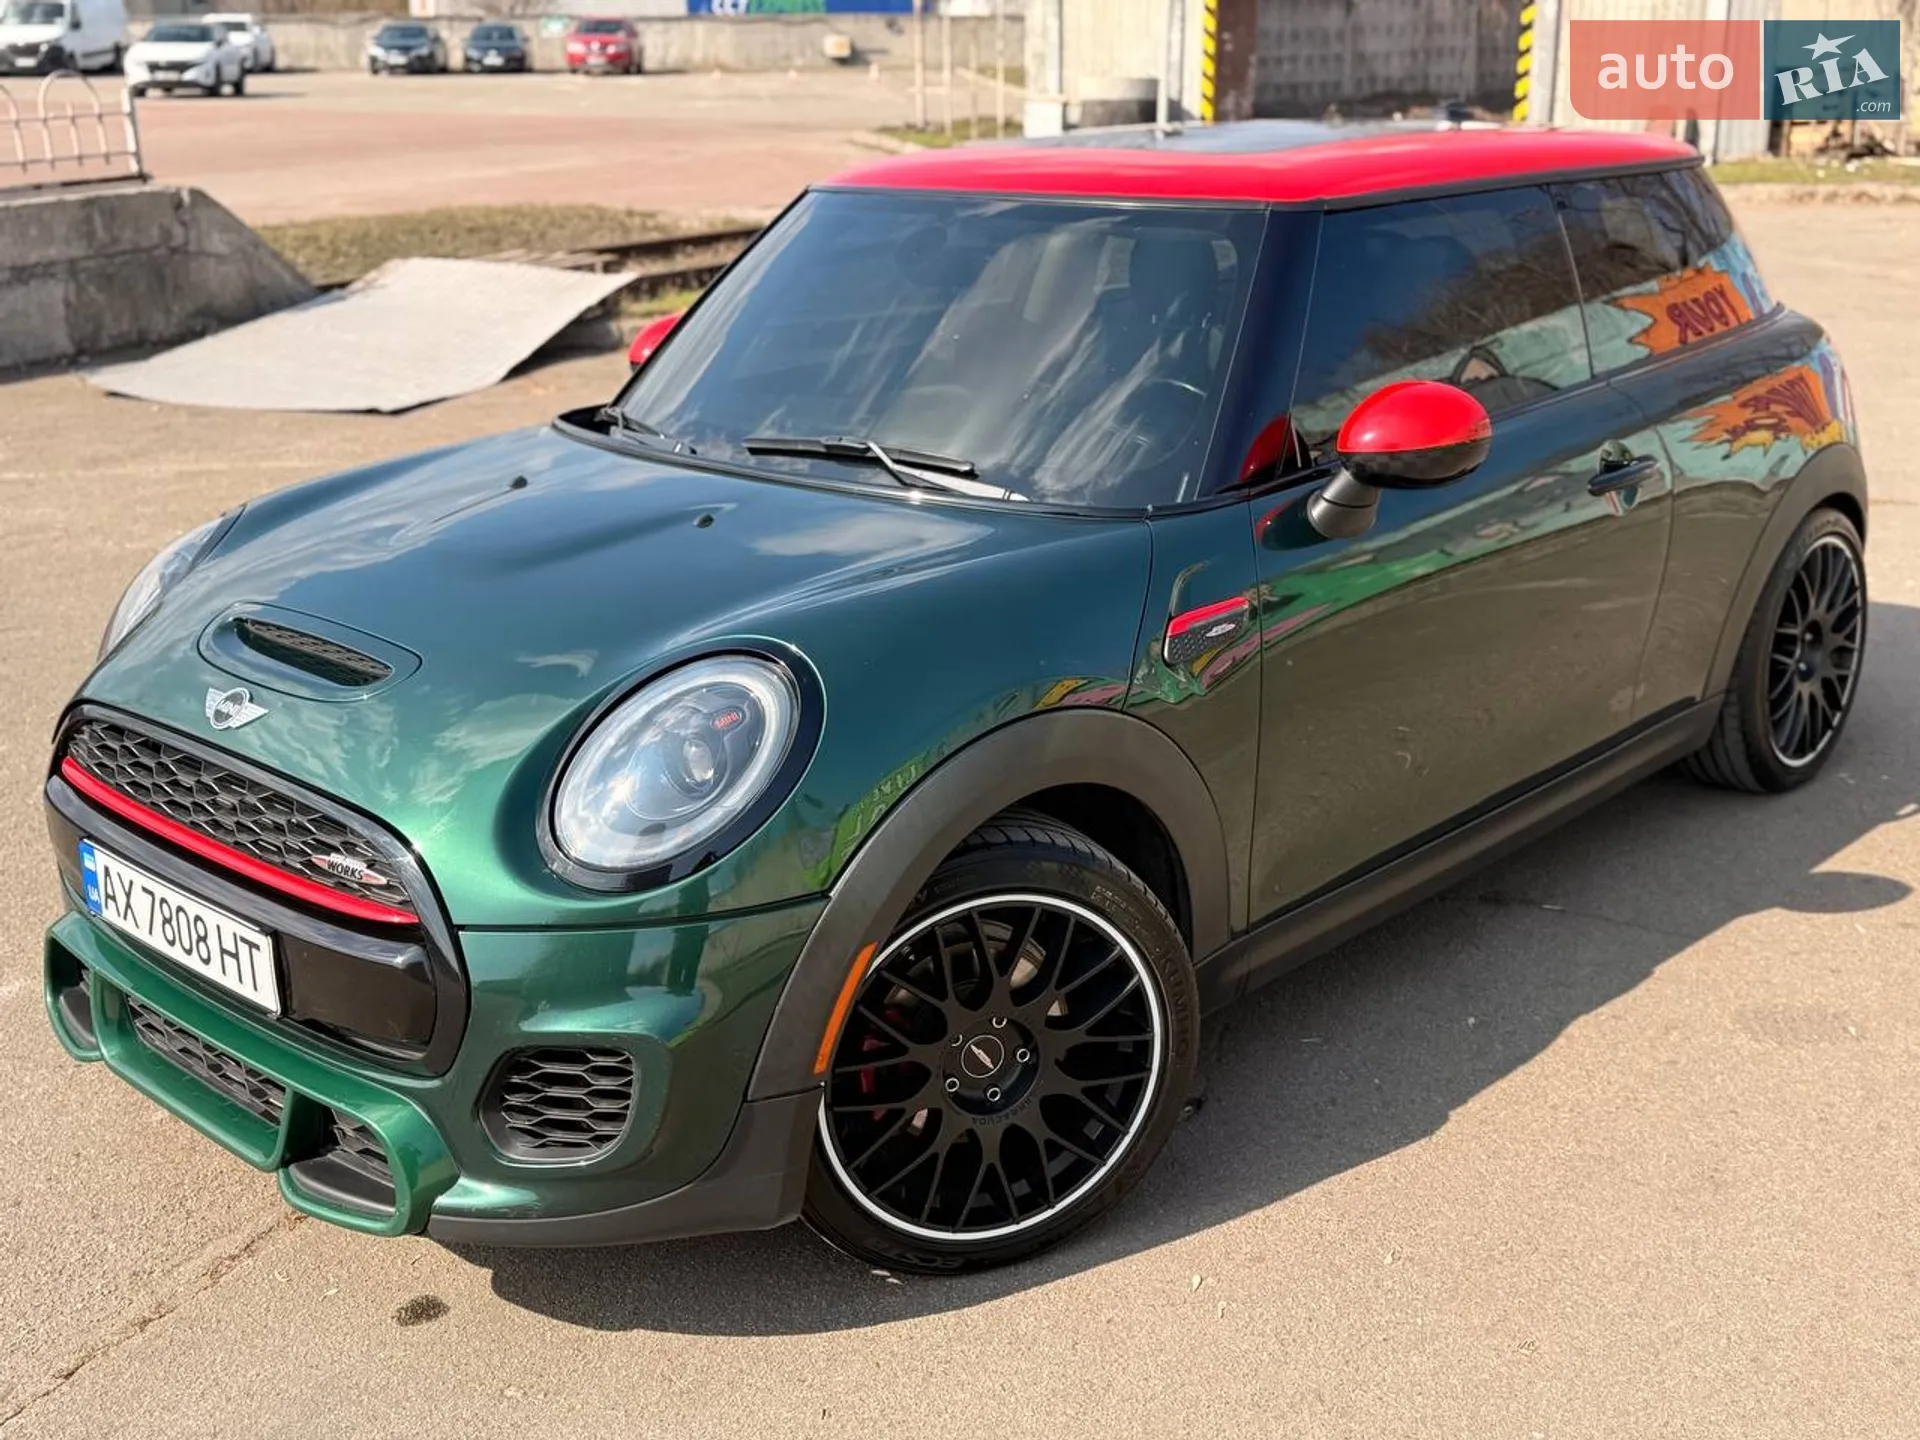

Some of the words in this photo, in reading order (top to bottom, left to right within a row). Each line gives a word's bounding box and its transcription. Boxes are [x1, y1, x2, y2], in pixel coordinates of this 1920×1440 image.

[327, 859, 363, 880] WORKS
[103, 865, 140, 930] AX
[141, 885, 212, 966] 7808
[216, 923, 262, 992] HT
